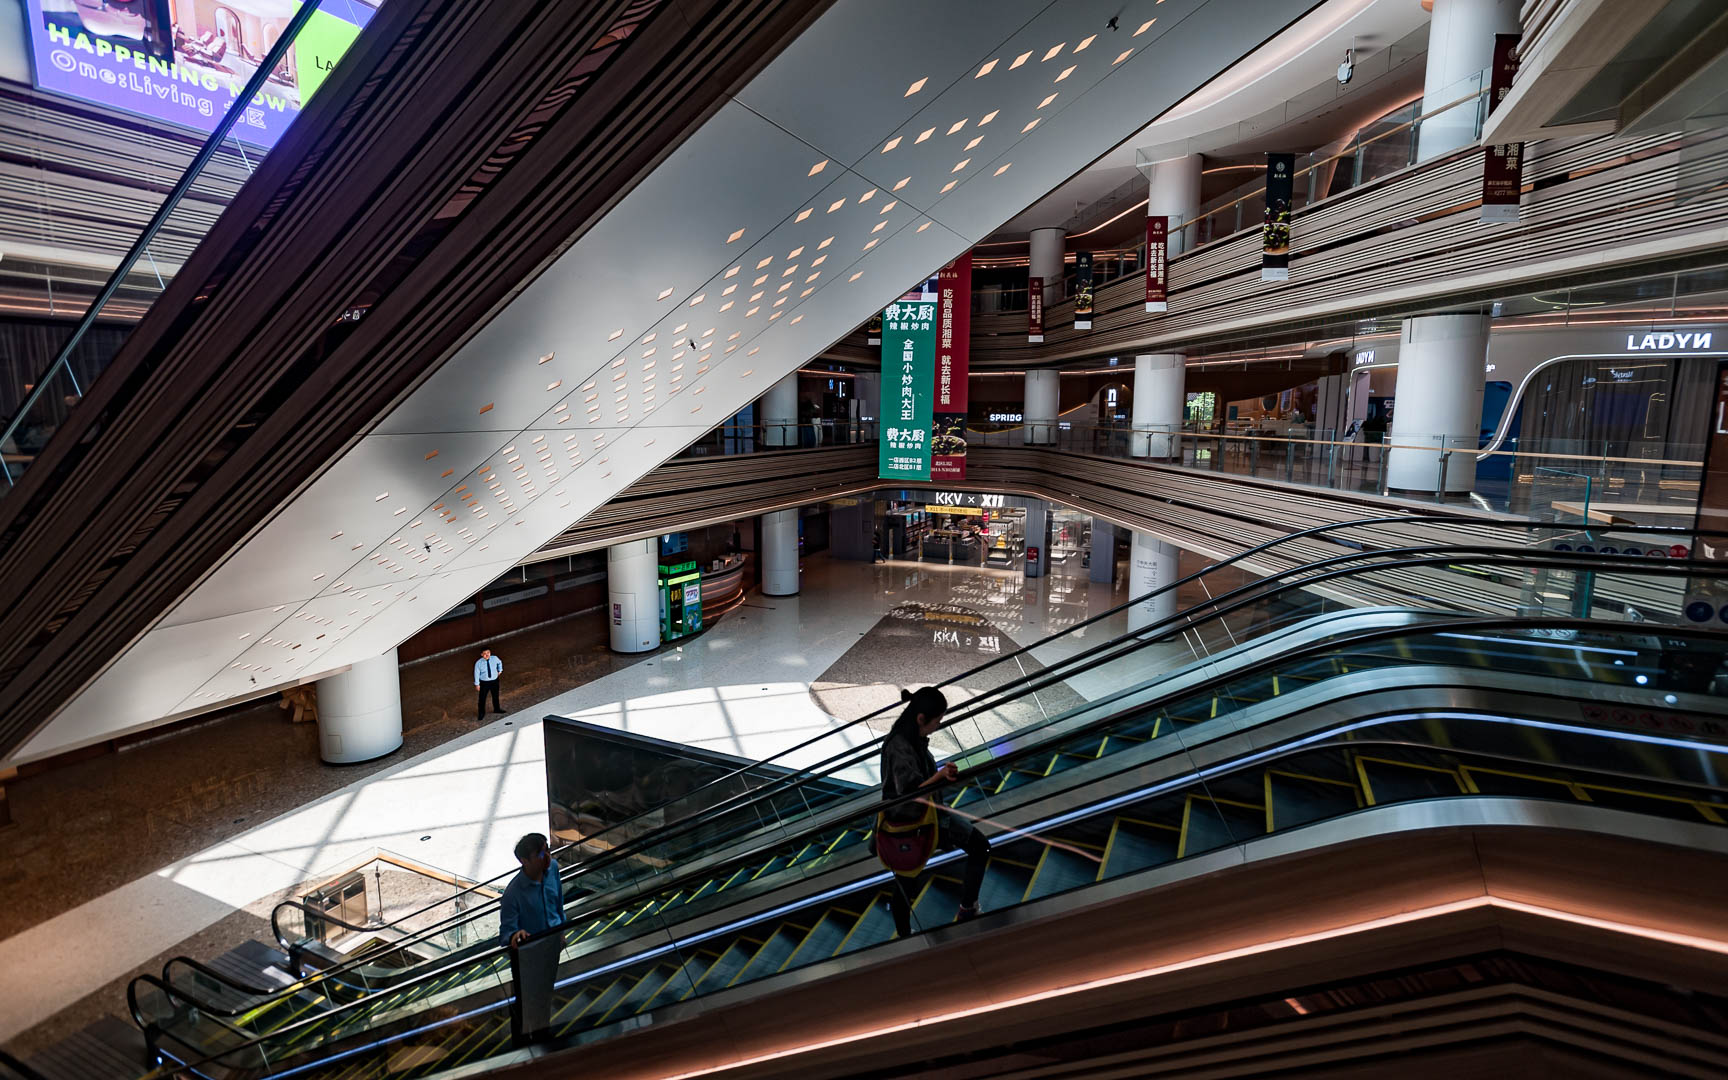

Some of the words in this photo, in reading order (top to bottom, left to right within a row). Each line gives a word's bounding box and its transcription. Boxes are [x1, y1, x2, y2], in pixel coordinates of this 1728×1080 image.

[48, 23, 219, 91] HAPPENING
[50, 50, 213, 117] One:Living
[885, 303, 935, 321] 费大厨
[941, 288, 954, 349] 吃高品质湘菜
[900, 338, 915, 421] 全国小炒肉大王
[940, 355, 952, 405] 就去新长福
[886, 427, 925, 442] 费大厨
[935, 491, 963, 505] KKV
